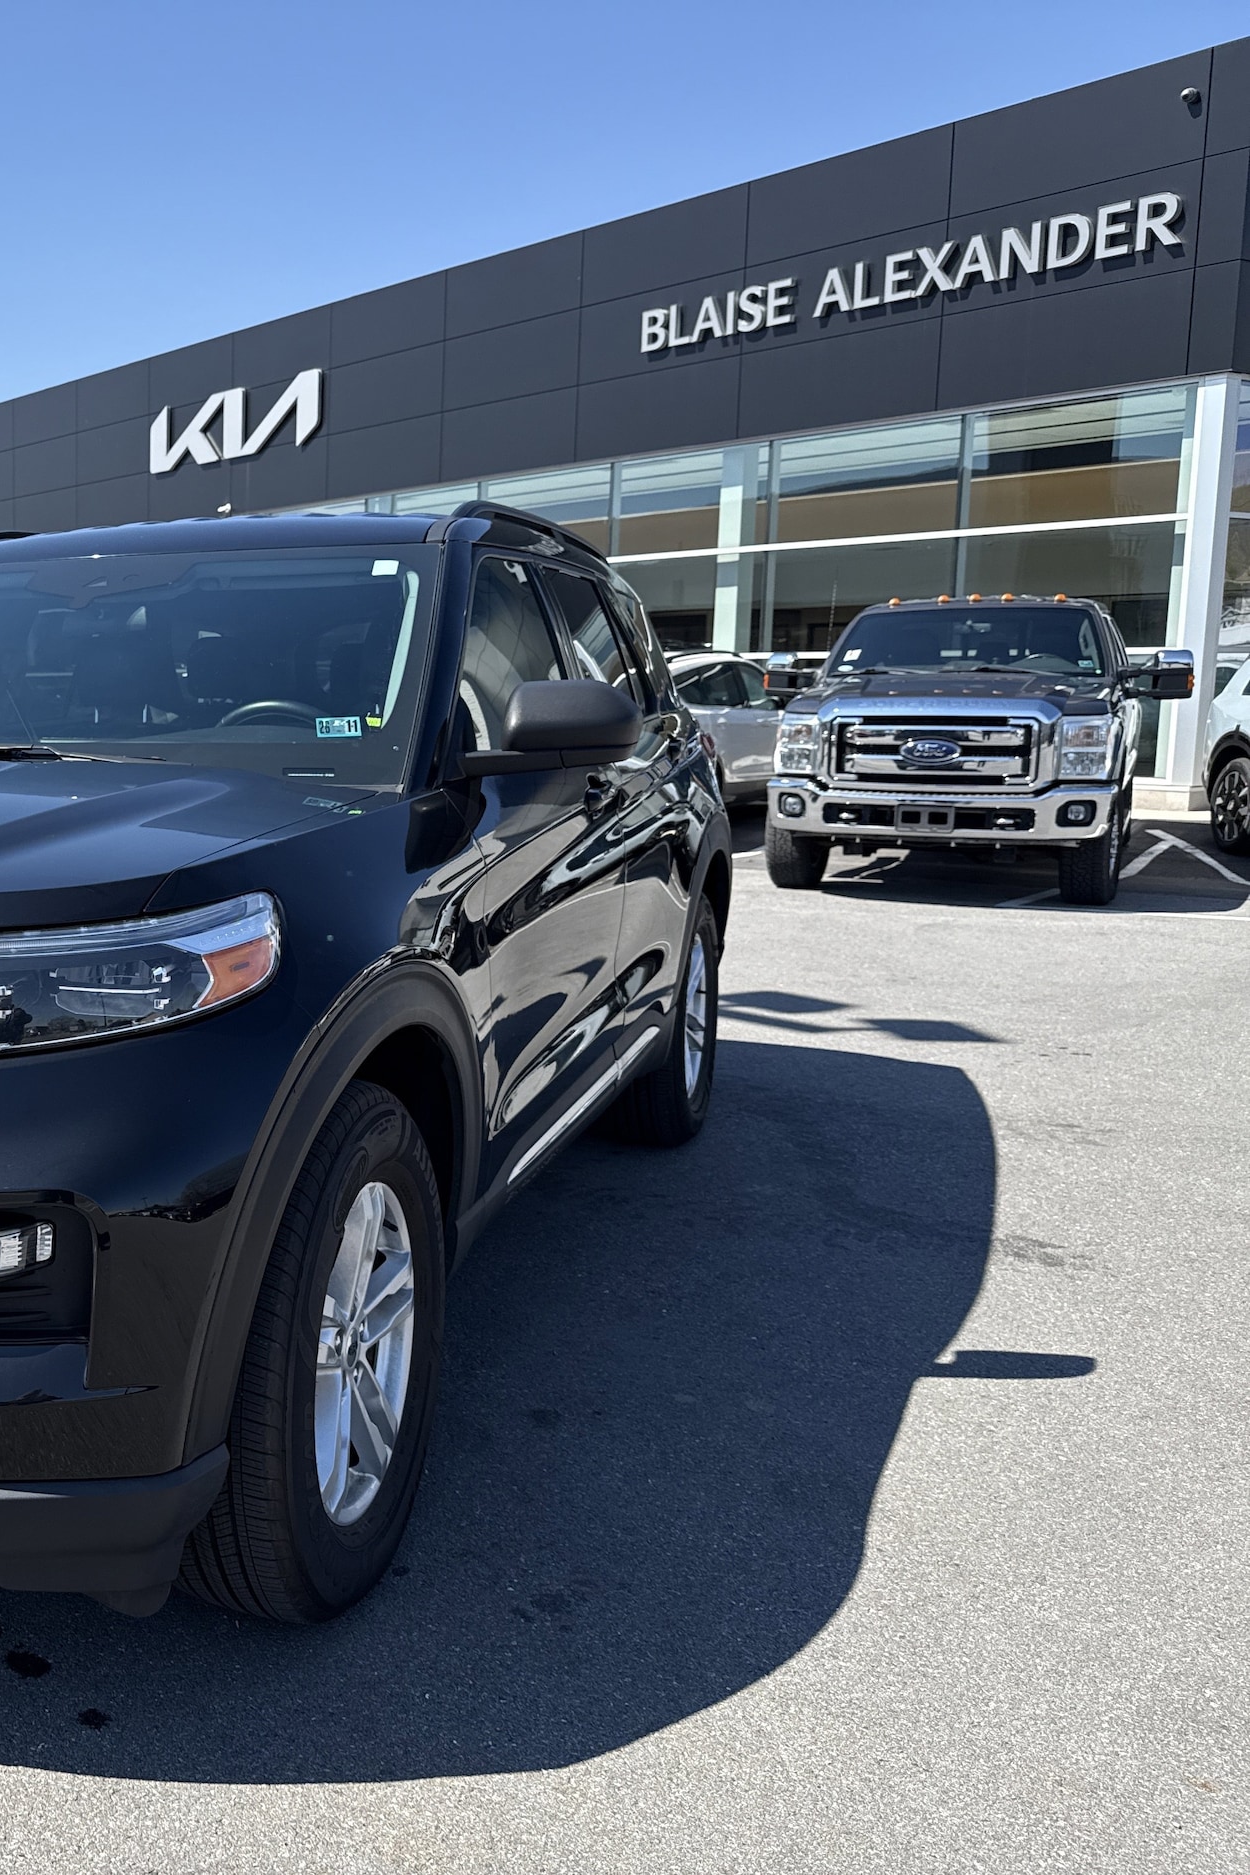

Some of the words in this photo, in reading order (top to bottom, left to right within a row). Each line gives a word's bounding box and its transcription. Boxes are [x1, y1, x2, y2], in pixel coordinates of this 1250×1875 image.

[640, 278, 795, 353] BLAISE
[813, 191, 1184, 319] ALEXANDER
[150, 368, 322, 475] KIA
[318, 720, 331, 734] 26
[346, 719, 359, 733] 11
